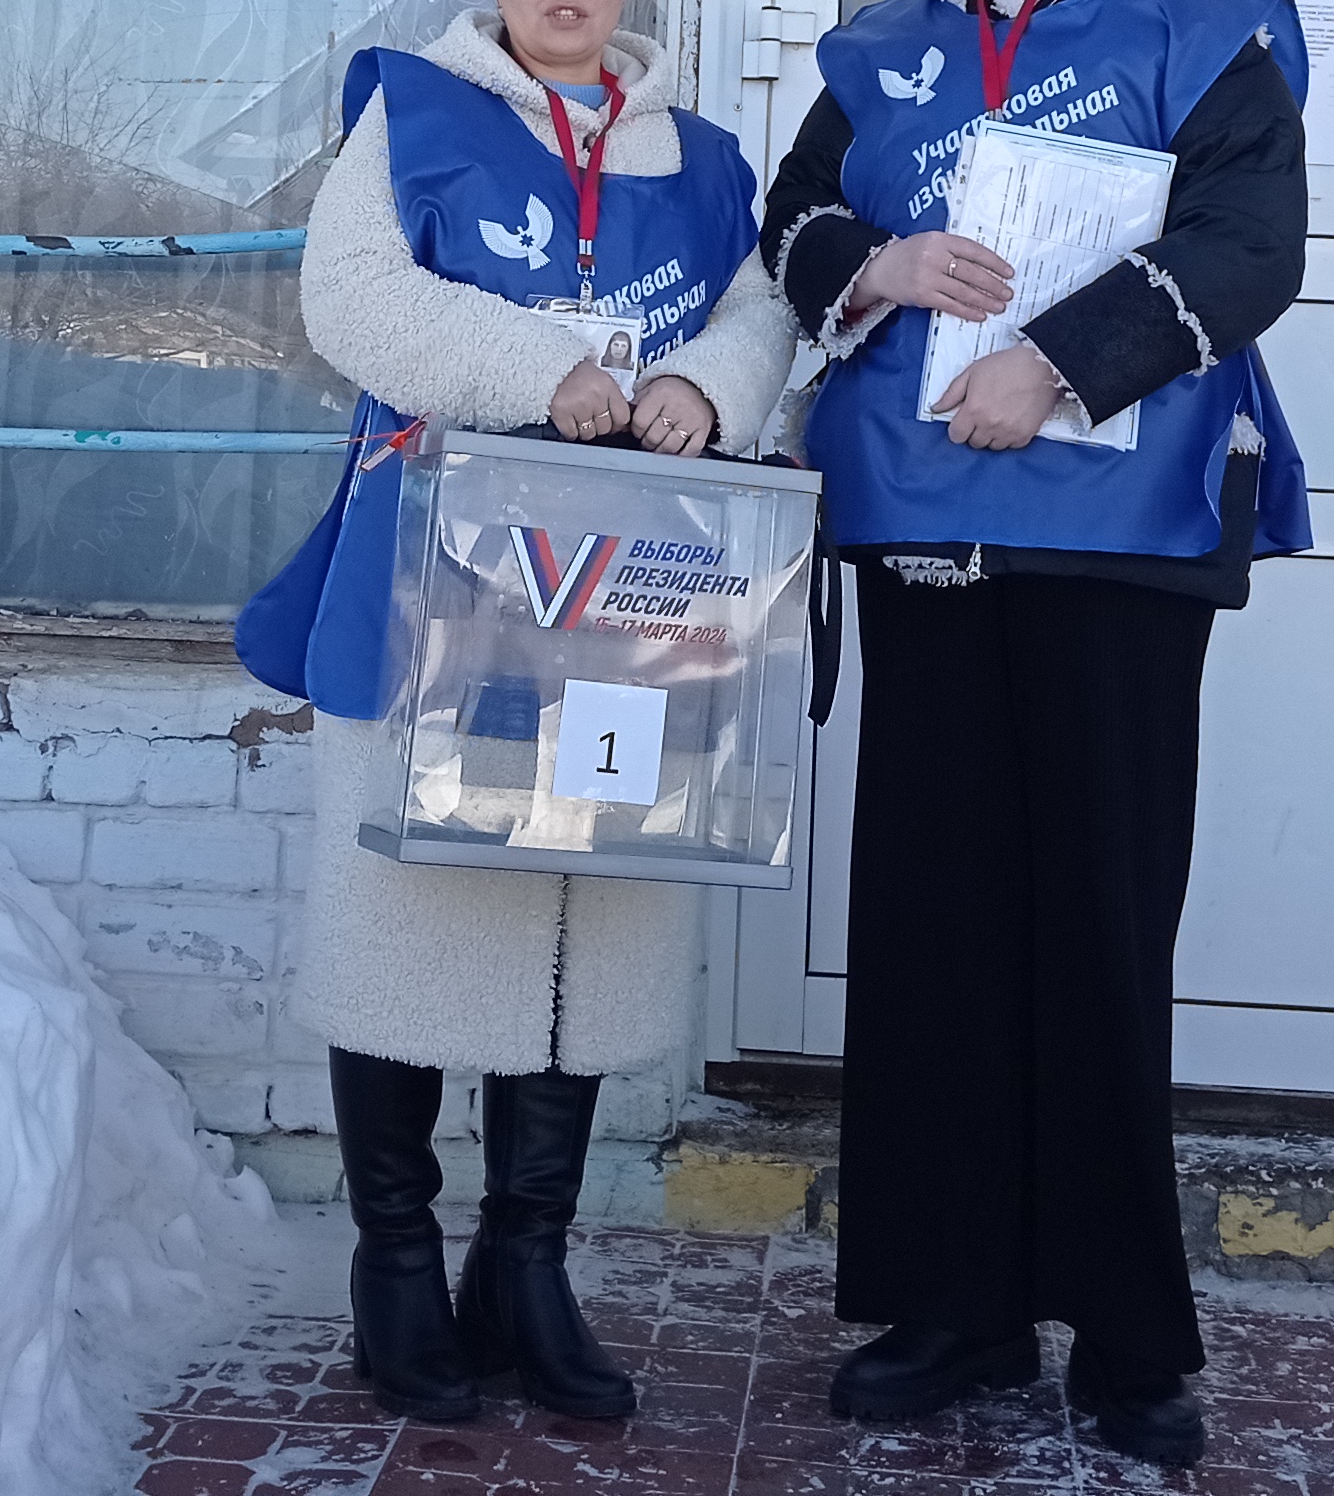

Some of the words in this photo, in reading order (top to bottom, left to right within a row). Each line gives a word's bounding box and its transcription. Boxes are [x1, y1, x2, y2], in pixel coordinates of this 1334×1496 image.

[628, 539, 725, 566] ВЫБОРЫ
[615, 565, 749, 597] ПРЕЗИДЕНТА
[601, 592, 691, 618] РОССИИ
[636, 620, 688, 641] МАРТА
[689, 626, 727, 644] 2024
[596, 731, 619, 775] 1
